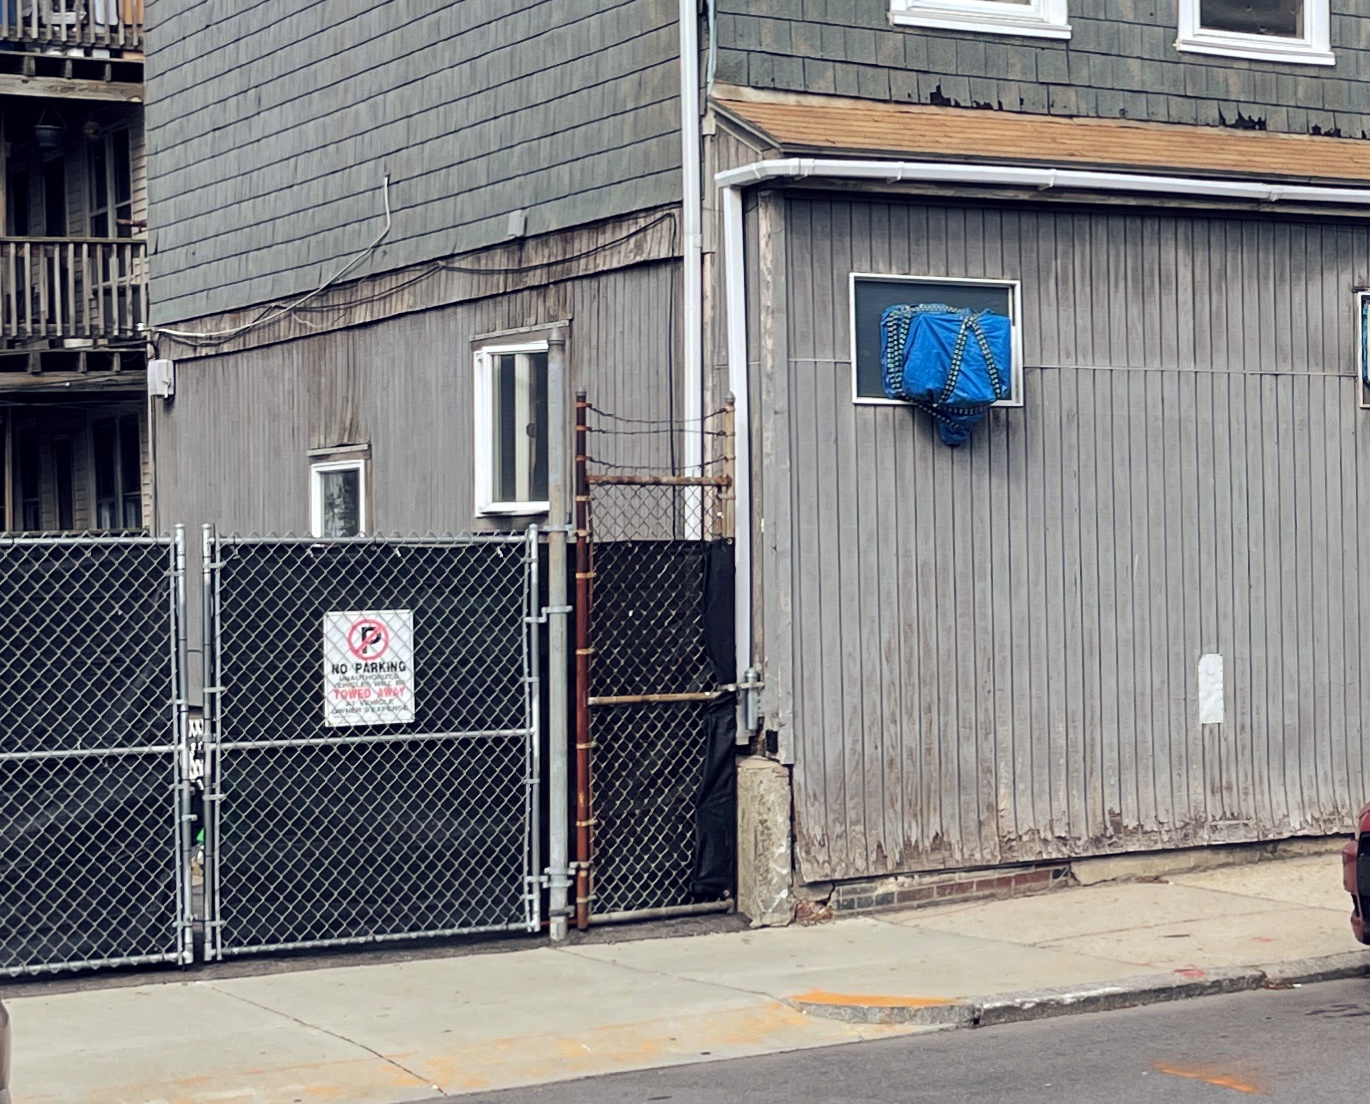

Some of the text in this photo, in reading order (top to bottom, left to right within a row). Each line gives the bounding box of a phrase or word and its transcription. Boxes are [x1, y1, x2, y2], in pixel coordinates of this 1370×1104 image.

[332, 661, 407, 674] NO PARKING
[334, 686, 405, 700] TOWED AWAY
